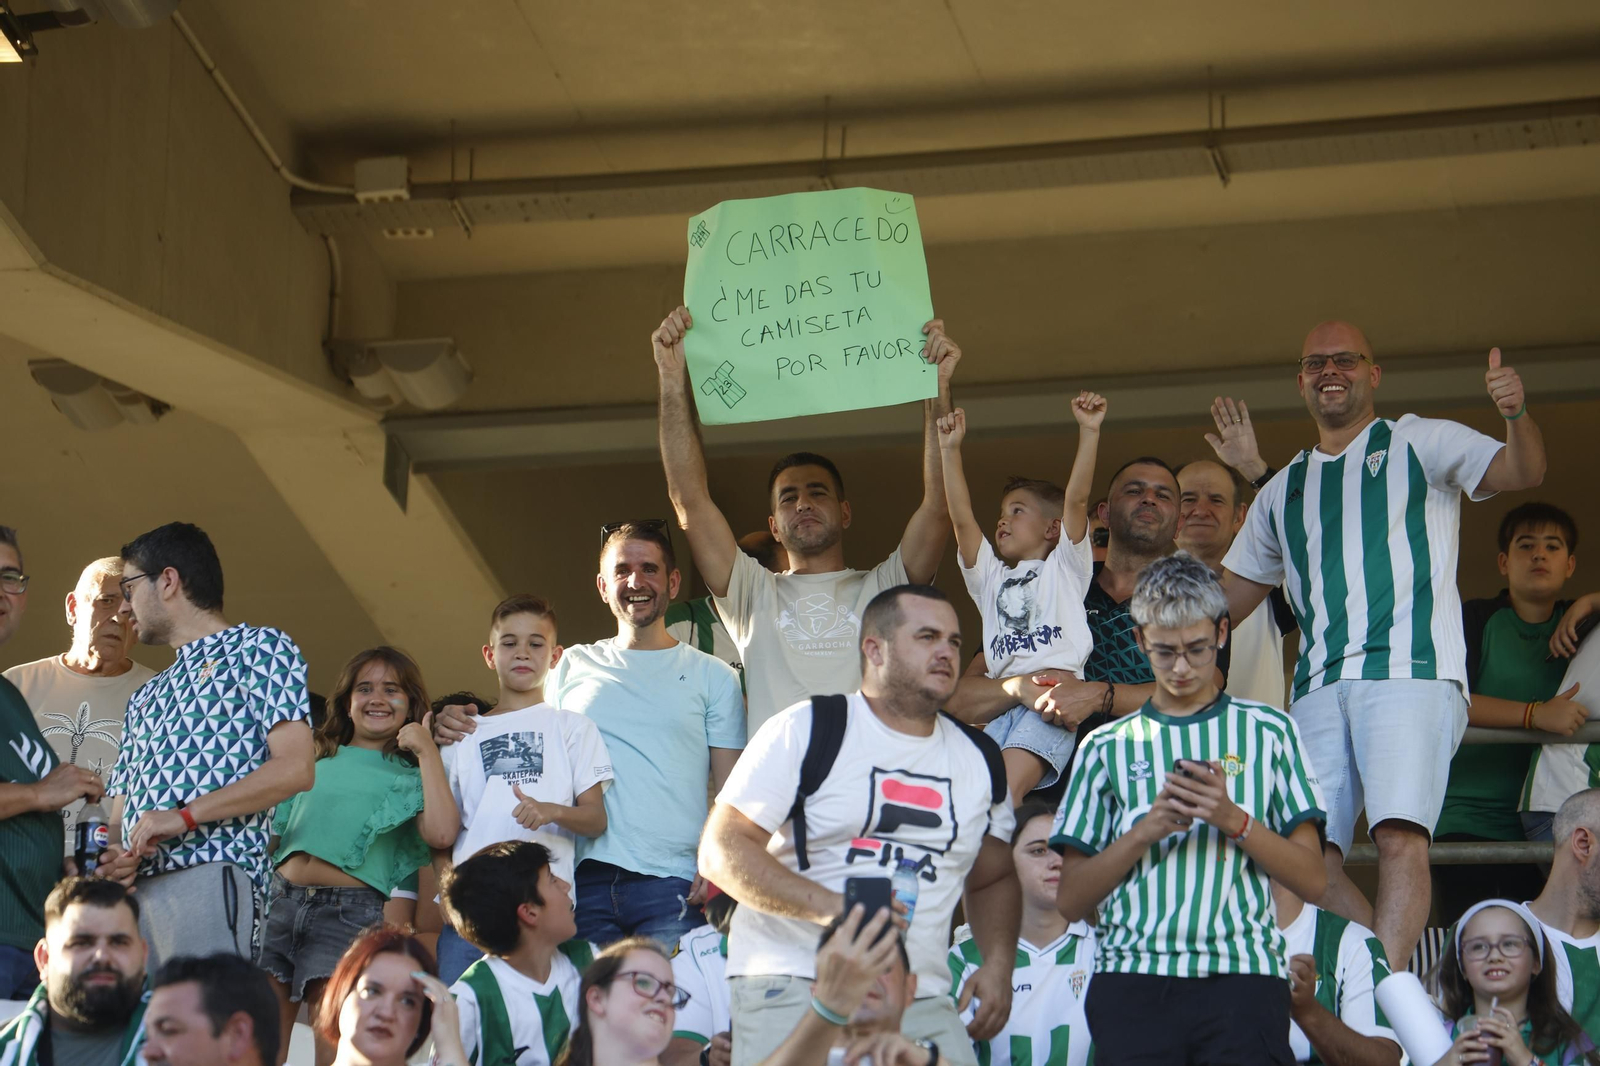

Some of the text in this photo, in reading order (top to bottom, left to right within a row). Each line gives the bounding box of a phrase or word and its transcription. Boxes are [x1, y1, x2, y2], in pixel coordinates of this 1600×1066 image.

[726, 217, 909, 266] CARRACEDO
[711, 270, 882, 322] ¿ME DAS TU
[776, 353, 827, 380] POR
[718, 379, 732, 396] 23
[798, 640, 853, 651] GARROCHA
[502, 770, 543, 780] SKATEPARK
